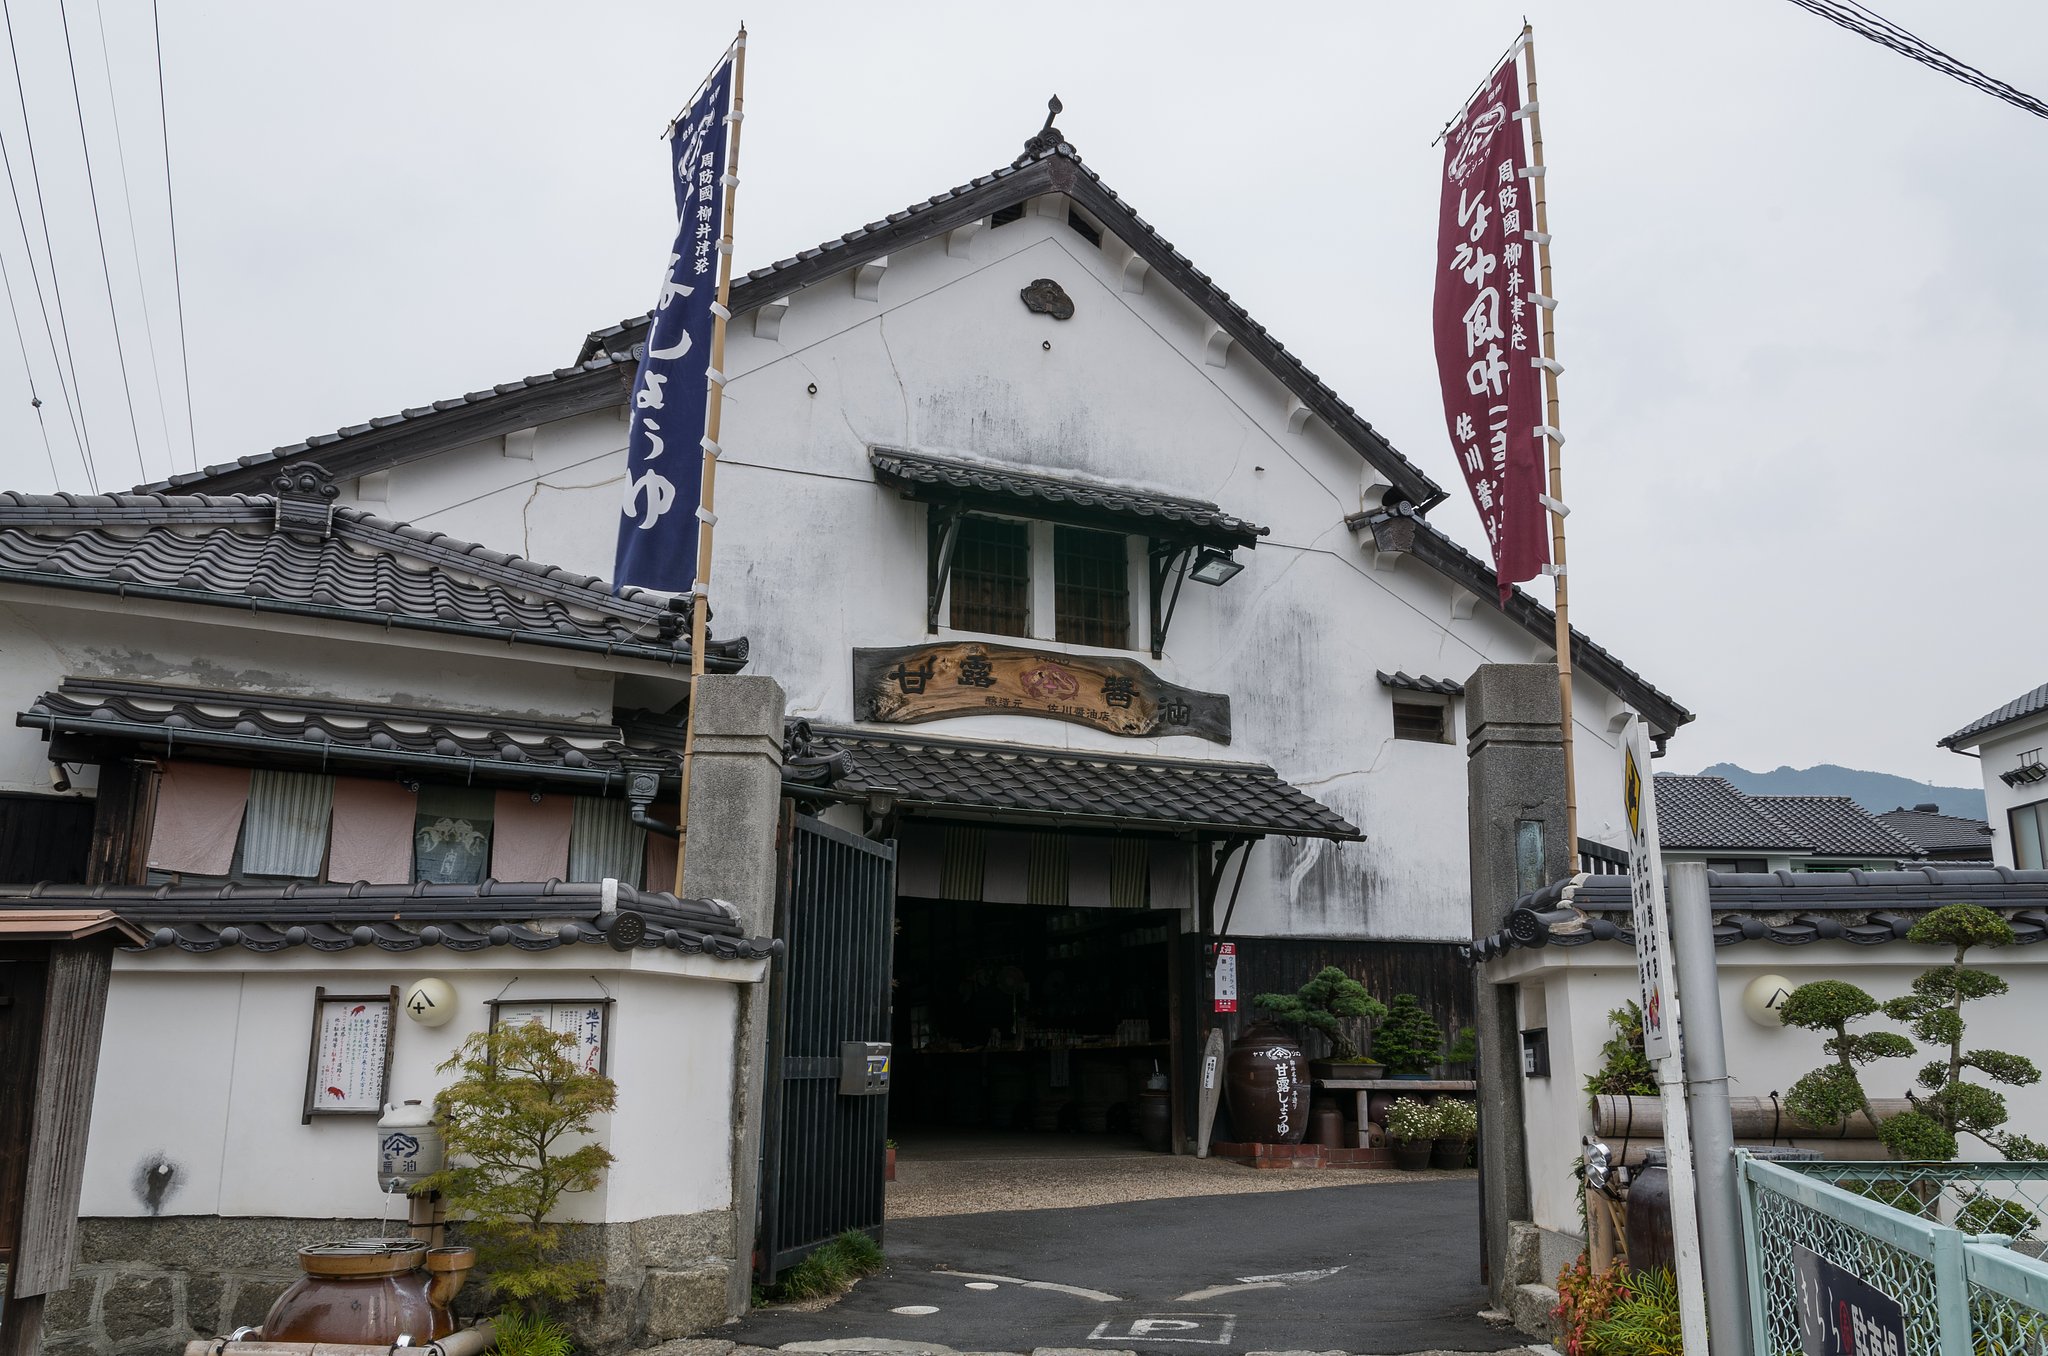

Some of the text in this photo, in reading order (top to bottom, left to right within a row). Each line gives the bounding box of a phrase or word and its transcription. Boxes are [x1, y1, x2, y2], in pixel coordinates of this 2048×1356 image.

[585, 1008, 600, 1045] 地下水
[1275, 1063, 1291, 1136] 甘露しょうゆ
[1128, 1319, 1200, 1336] P
